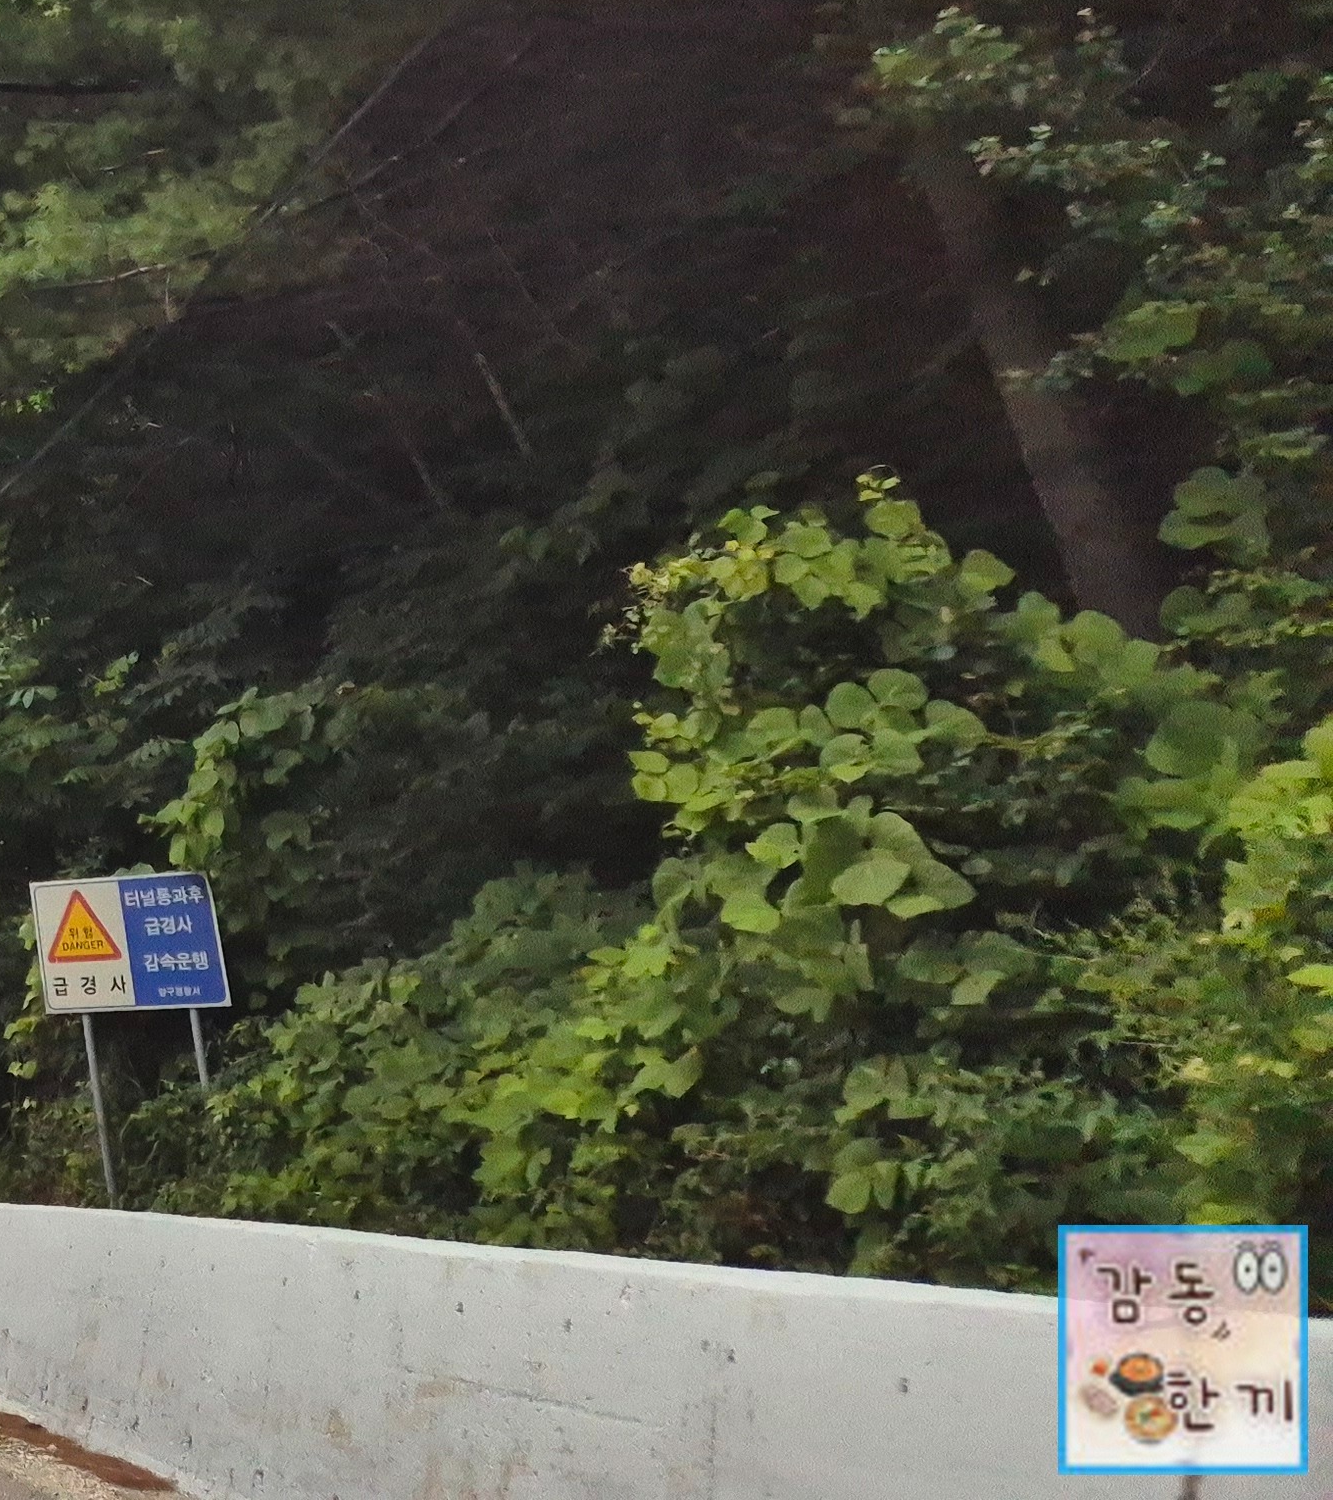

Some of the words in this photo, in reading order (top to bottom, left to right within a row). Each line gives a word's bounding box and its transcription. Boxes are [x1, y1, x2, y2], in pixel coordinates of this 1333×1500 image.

[144, 914, 193, 936] 급경사
[62, 939, 104, 952] DANGER
[143, 951, 209, 972] 감속운행
[53, 974, 126, 997] 급경사
